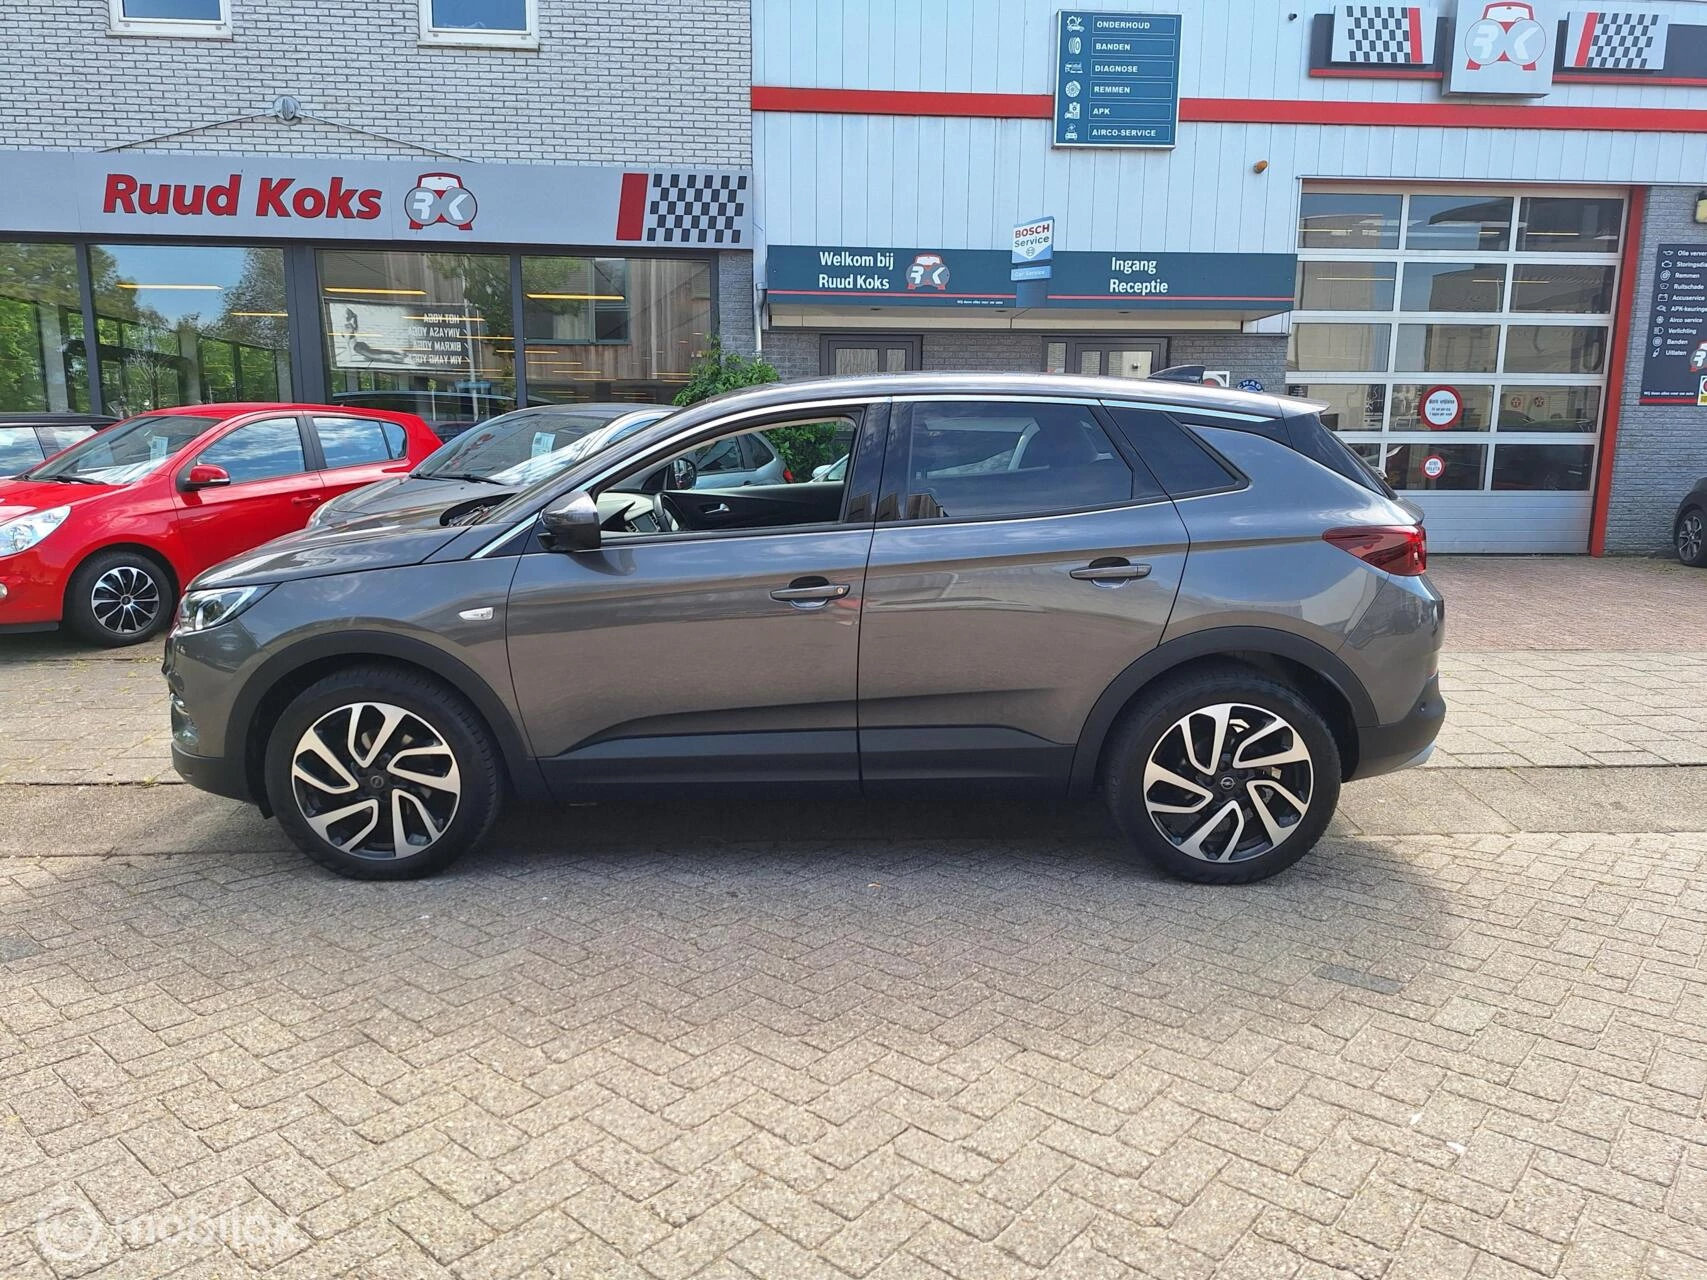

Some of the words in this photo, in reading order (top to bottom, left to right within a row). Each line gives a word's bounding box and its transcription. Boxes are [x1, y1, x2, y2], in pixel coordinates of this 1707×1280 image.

[1096, 20, 1151, 29] ONDERHOUD
[1095, 43, 1131, 51] BANDEN
[1095, 65, 1138, 73] DIAGNOSE
[1094, 86, 1131, 94] REMMEN
[1092, 129, 1157, 137] AIRCO-SERVICE
[103, 173, 242, 216] Ruud
[255, 177, 383, 220] Koks
[1014, 223, 1050, 239] BOSCH
[1014, 235, 1050, 248] Service
[819, 252, 874, 268] Welkom
[876, 253, 894, 271] bij
[1111, 257, 1157, 274] Ingang
[818, 274, 853, 289] Ruud
[856, 275, 890, 290] Koks
[1109, 279, 1168, 295] Receptie
